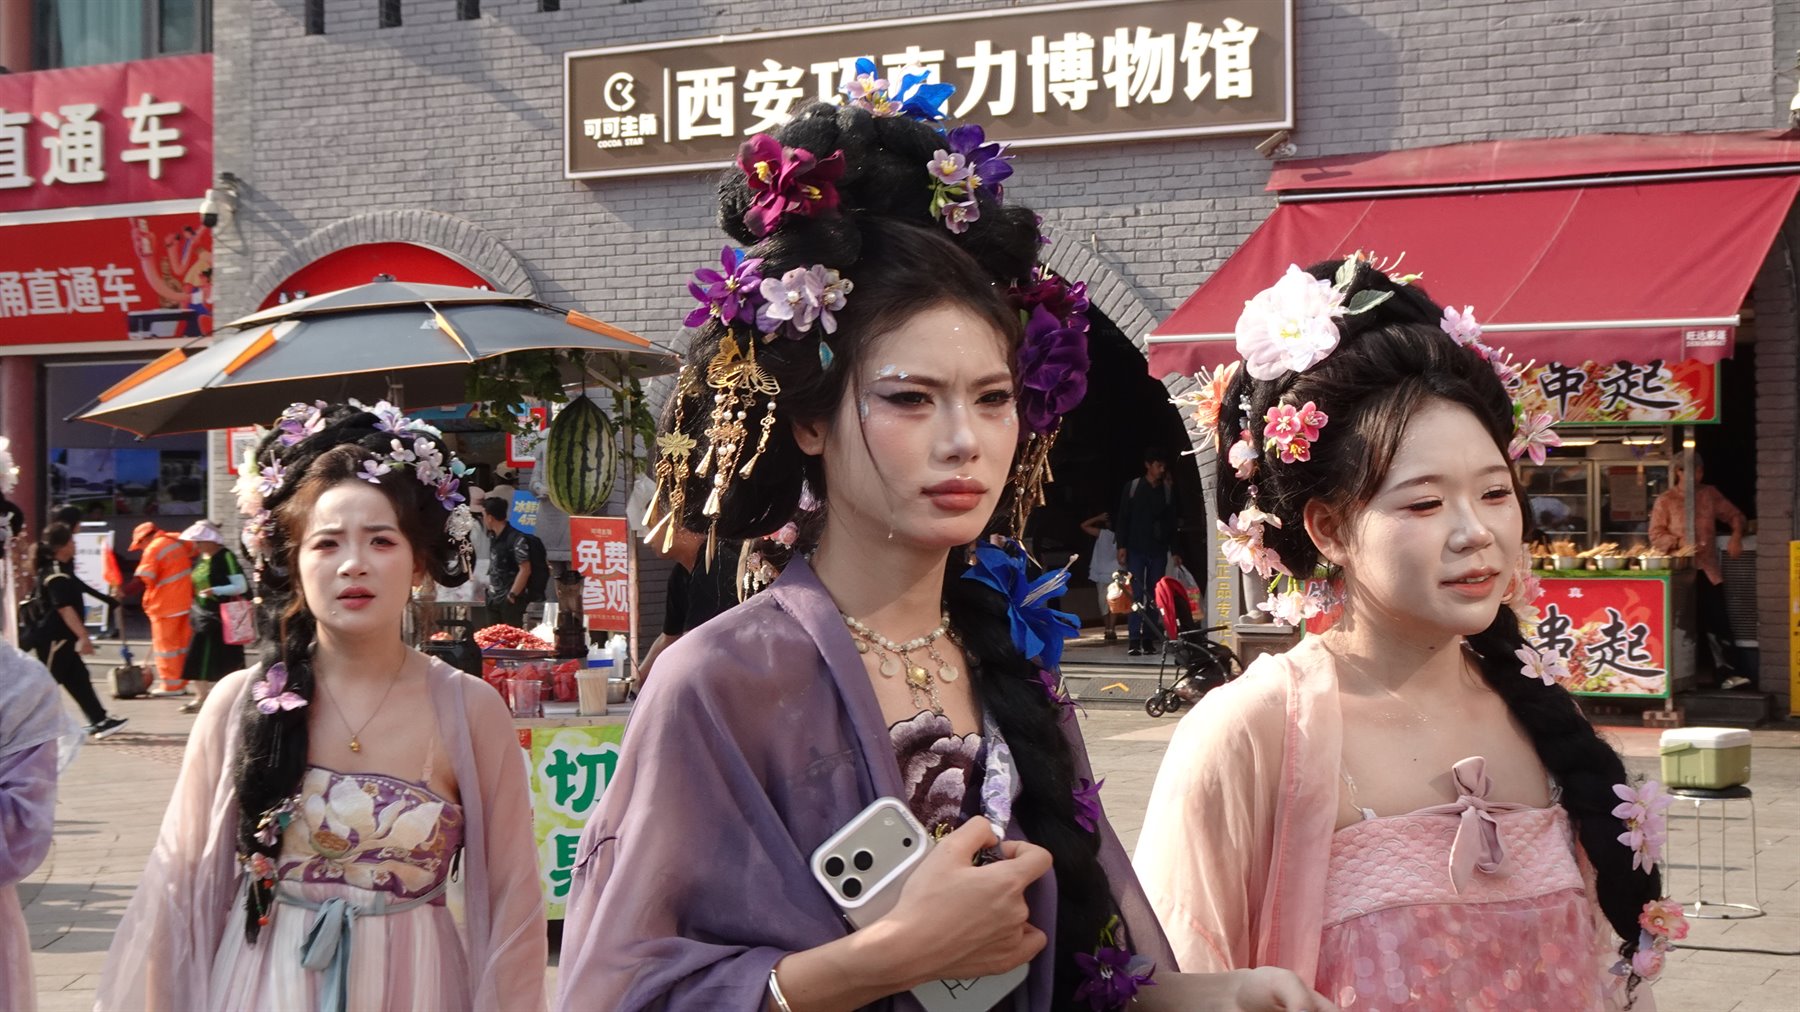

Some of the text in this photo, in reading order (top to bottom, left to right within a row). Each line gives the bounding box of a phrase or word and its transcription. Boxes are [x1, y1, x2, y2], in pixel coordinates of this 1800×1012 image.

[624, 137, 645, 146] STAR
[576, 540, 628, 576] 免费
[582, 576, 629, 613] 参观
